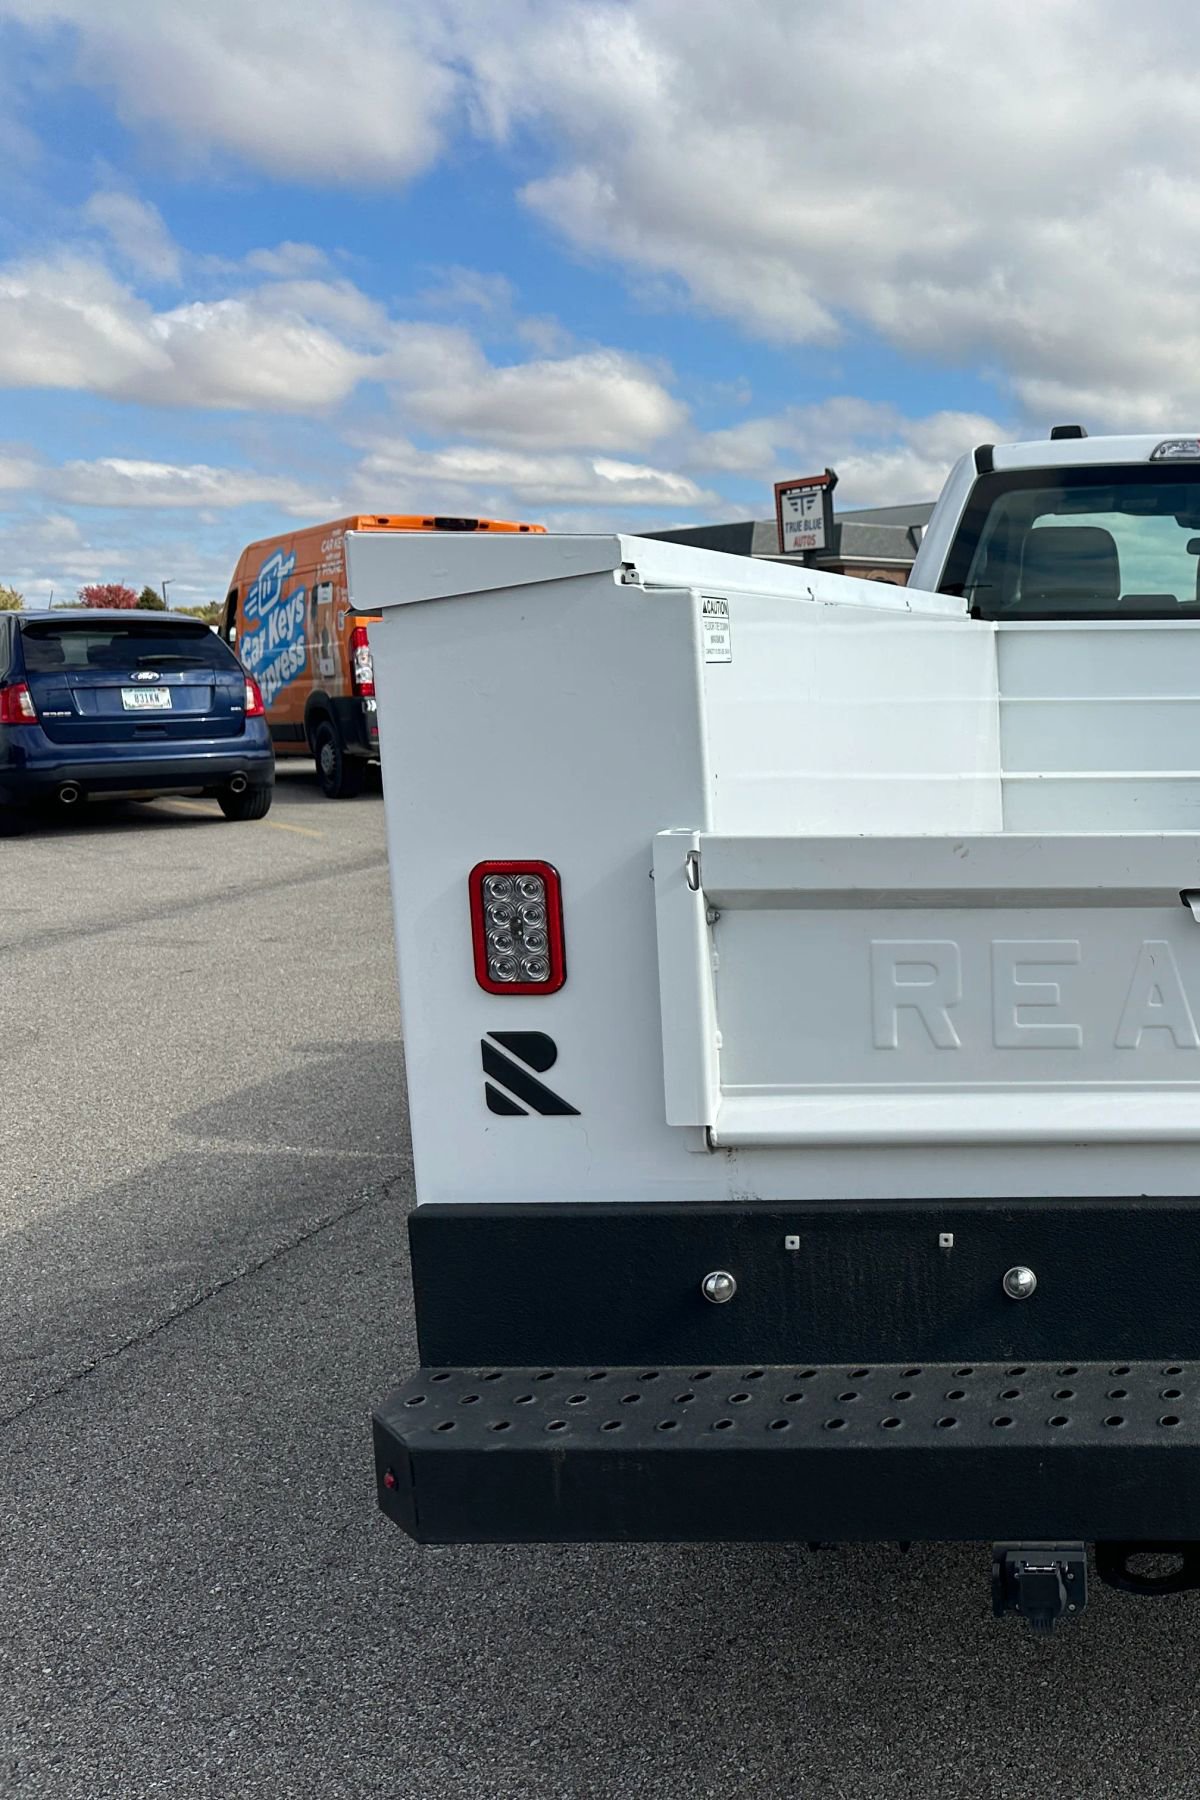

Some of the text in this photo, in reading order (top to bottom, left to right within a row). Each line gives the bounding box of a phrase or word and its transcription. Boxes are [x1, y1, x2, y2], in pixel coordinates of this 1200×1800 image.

[785, 517, 822, 534] TRUE BLUE
[793, 534, 816, 548] AUTOS
[707, 600, 728, 615] CAUTION
[241, 591, 305, 672] Car Keys
[254, 634, 305, 704] xpress
